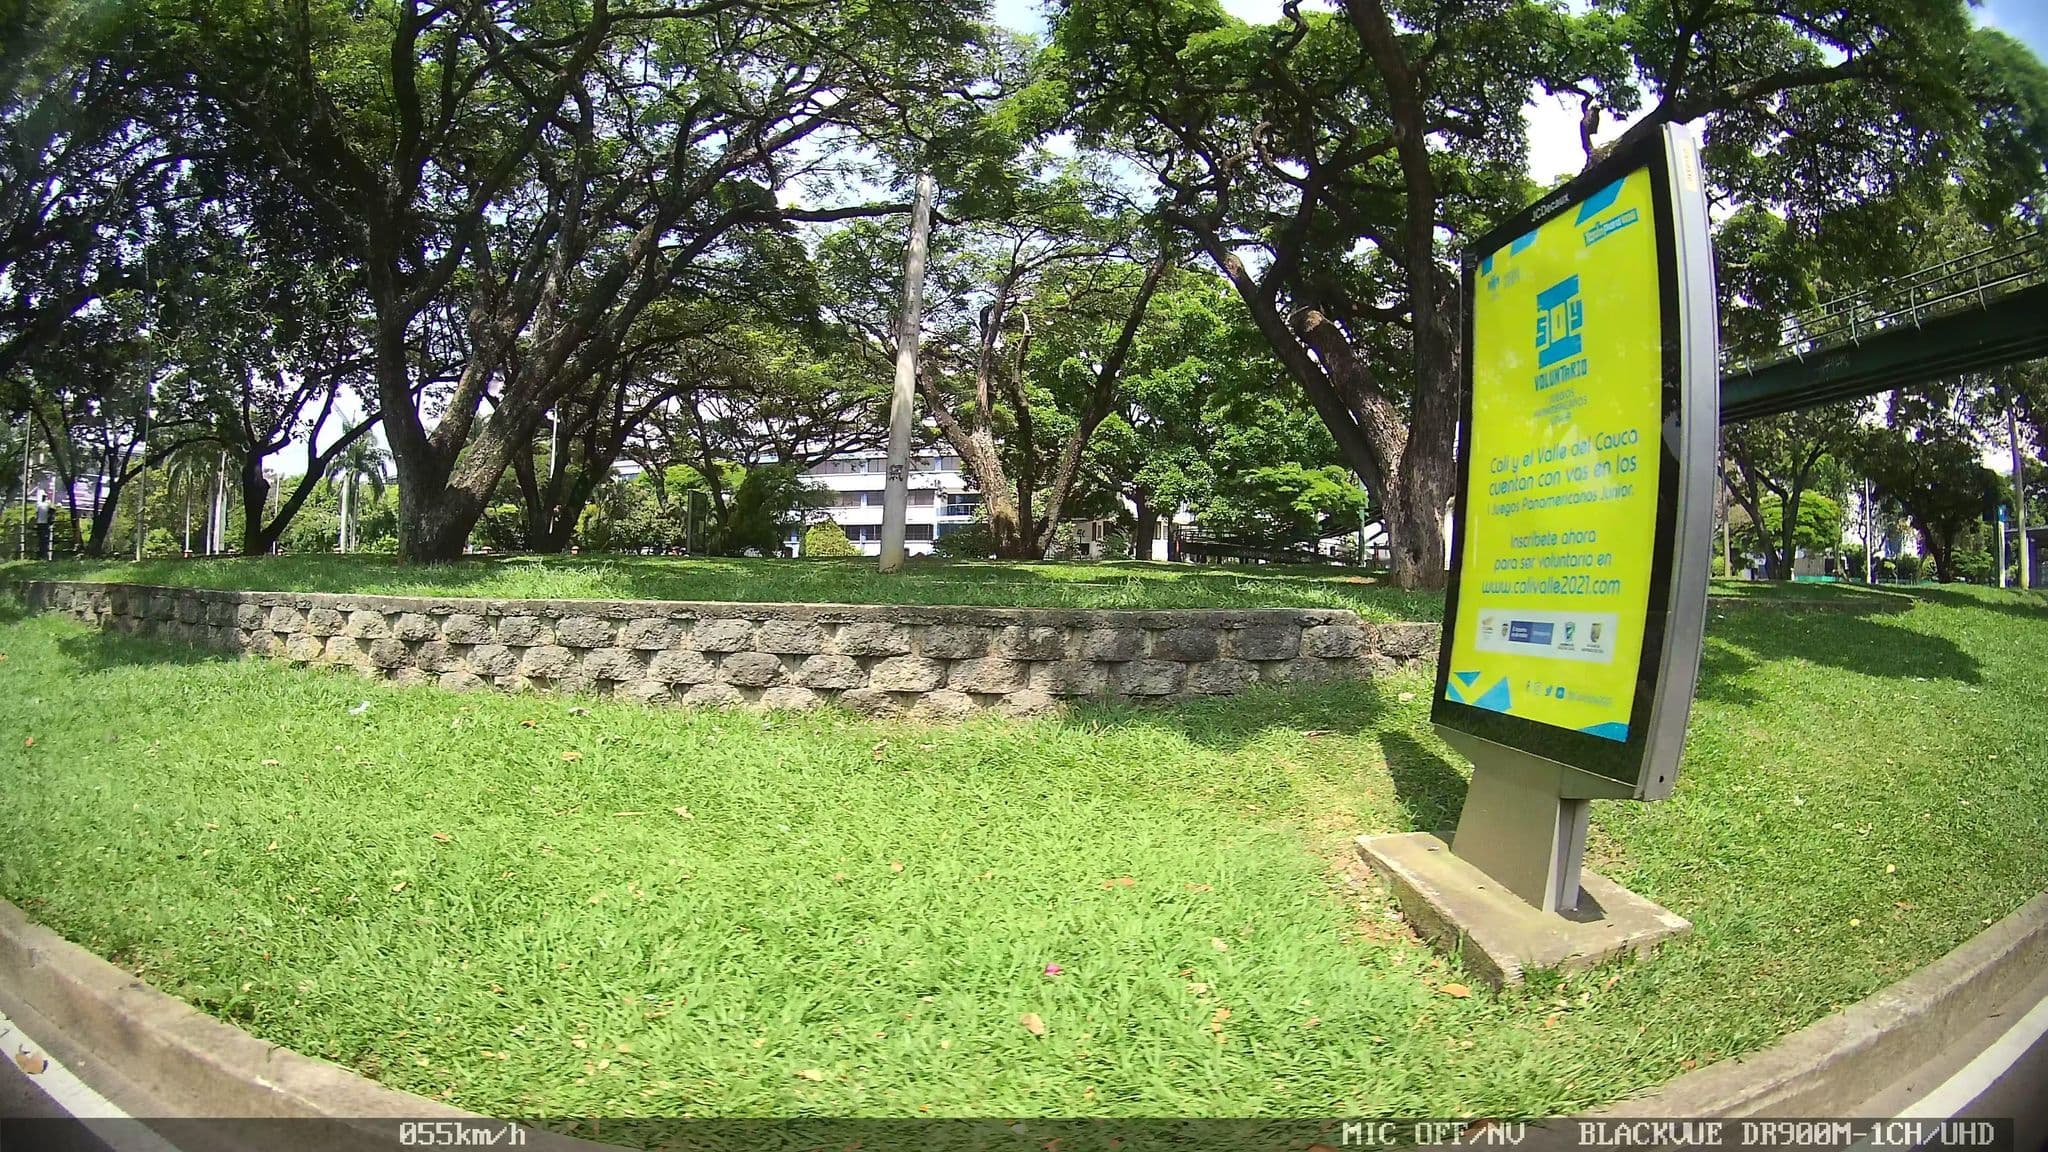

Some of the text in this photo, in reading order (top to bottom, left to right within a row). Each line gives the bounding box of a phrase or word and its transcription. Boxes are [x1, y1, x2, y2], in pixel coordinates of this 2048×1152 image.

[1531, 192, 1571, 223] JCDecaux
[1534, 359, 1588, 391] VOLUNTARIO
[1490, 429, 1639, 473] Cali y el Valle del Cauca
[1489, 475, 1534, 496] cuentan
[1538, 470, 1561, 487] con
[1594, 460, 1611, 477] en
[1616, 453, 1637, 474] los
[1491, 501, 1520, 517] Juegos
[1522, 490, 1598, 511] Panamericanos
[1561, 528, 1597, 545] ahora
[1494, 551, 1612, 572] para ser voluntario en
[1482, 575, 1621, 595] www.calivalle2021.com
